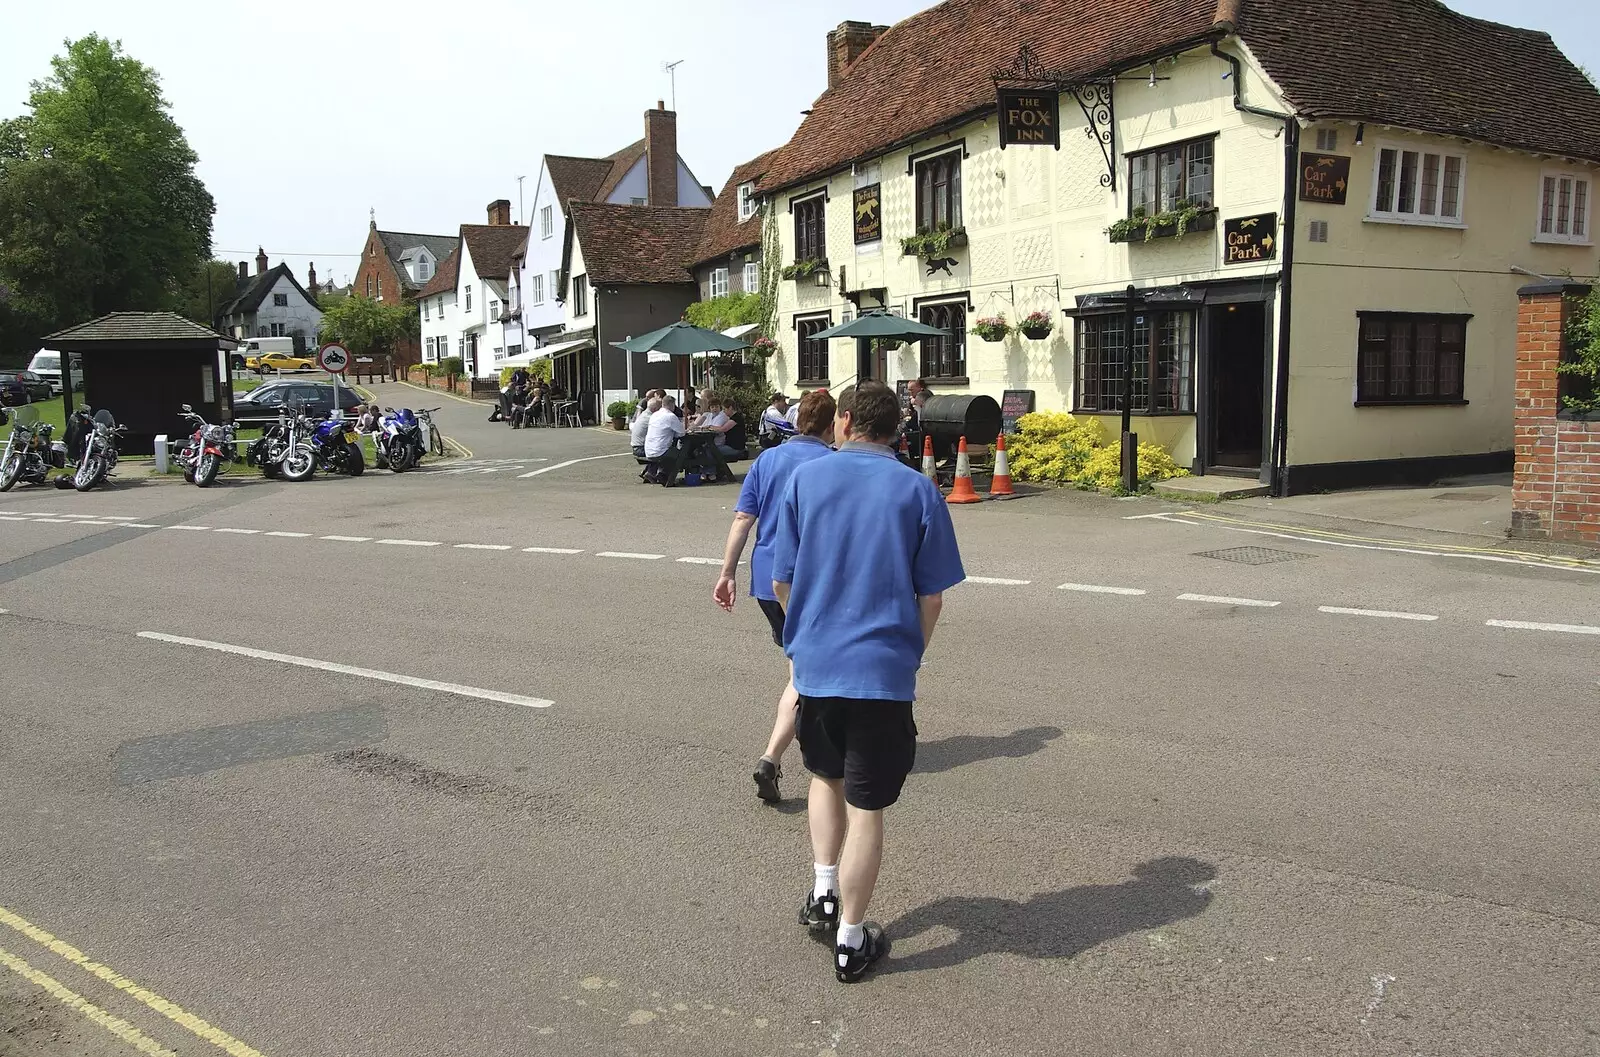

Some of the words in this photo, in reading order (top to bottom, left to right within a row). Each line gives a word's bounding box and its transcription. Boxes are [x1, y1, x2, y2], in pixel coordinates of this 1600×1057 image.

[1018, 98, 1040, 106] THE
[1008, 110, 1051, 126] FOX
[1017, 129, 1044, 140] INN
[1304, 166, 1327, 182] Car
[1305, 182, 1333, 199] Park
[1228, 232, 1251, 245] Car
[1229, 245, 1261, 261] Park
